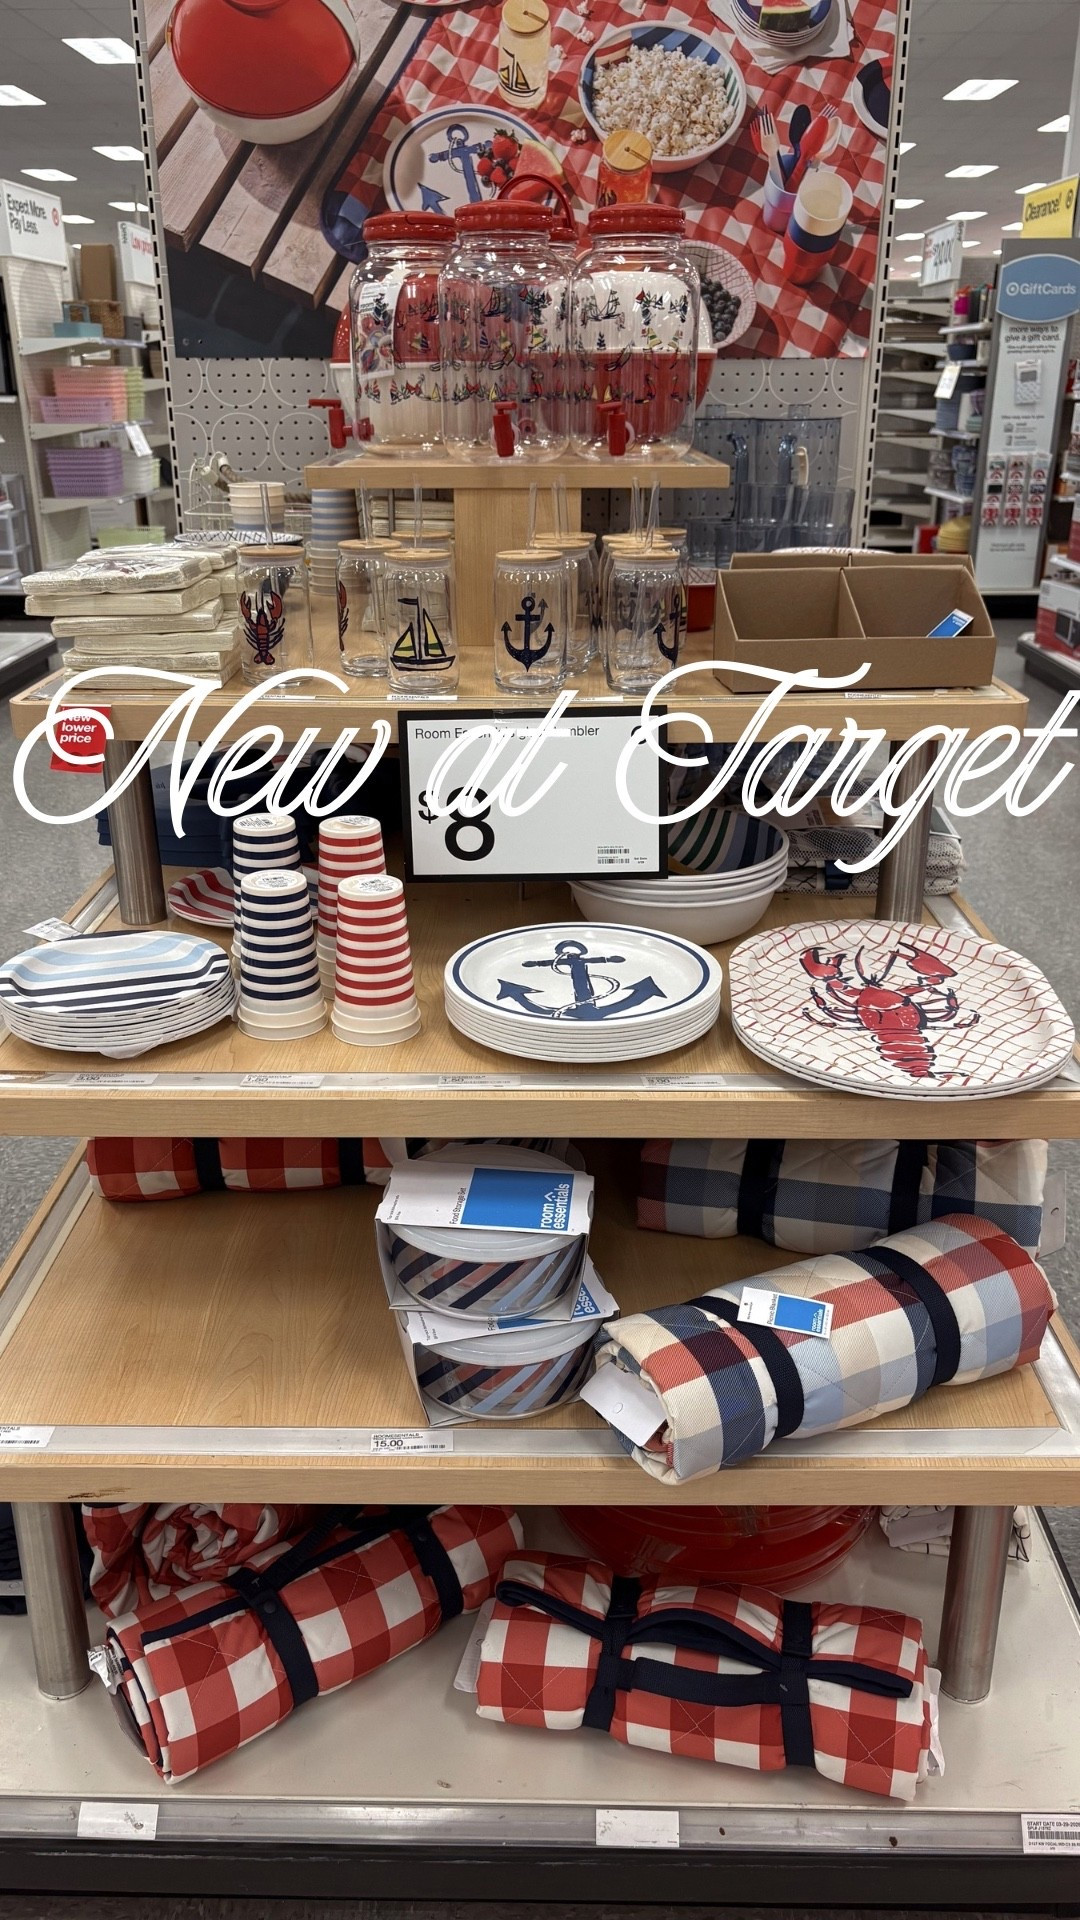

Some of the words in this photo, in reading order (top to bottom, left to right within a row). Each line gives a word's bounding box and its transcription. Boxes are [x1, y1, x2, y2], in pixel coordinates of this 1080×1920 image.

[7, 194, 30, 216] Expect
[1025, 193, 1062, 222] Clearance!
[9, 212, 22, 234] Pay
[1019, 283, 1077, 295] GiftCards
[1029, 326, 1049, 334] ways
[1050, 325, 1059, 333] to
[1005, 335, 1020, 343] give
[1027, 334, 1041, 343] gift
[61, 721, 98, 733] lower
[59, 733, 92, 744] price
[415, 728, 451, 739] Room
[452, 1195, 467, 1213] Storage
[553, 1183, 570, 1230] essentials
[449, 1212, 460, 1225] Food
[540, 1203, 555, 1229] room
[374, 1439, 404, 1447] 15.00
